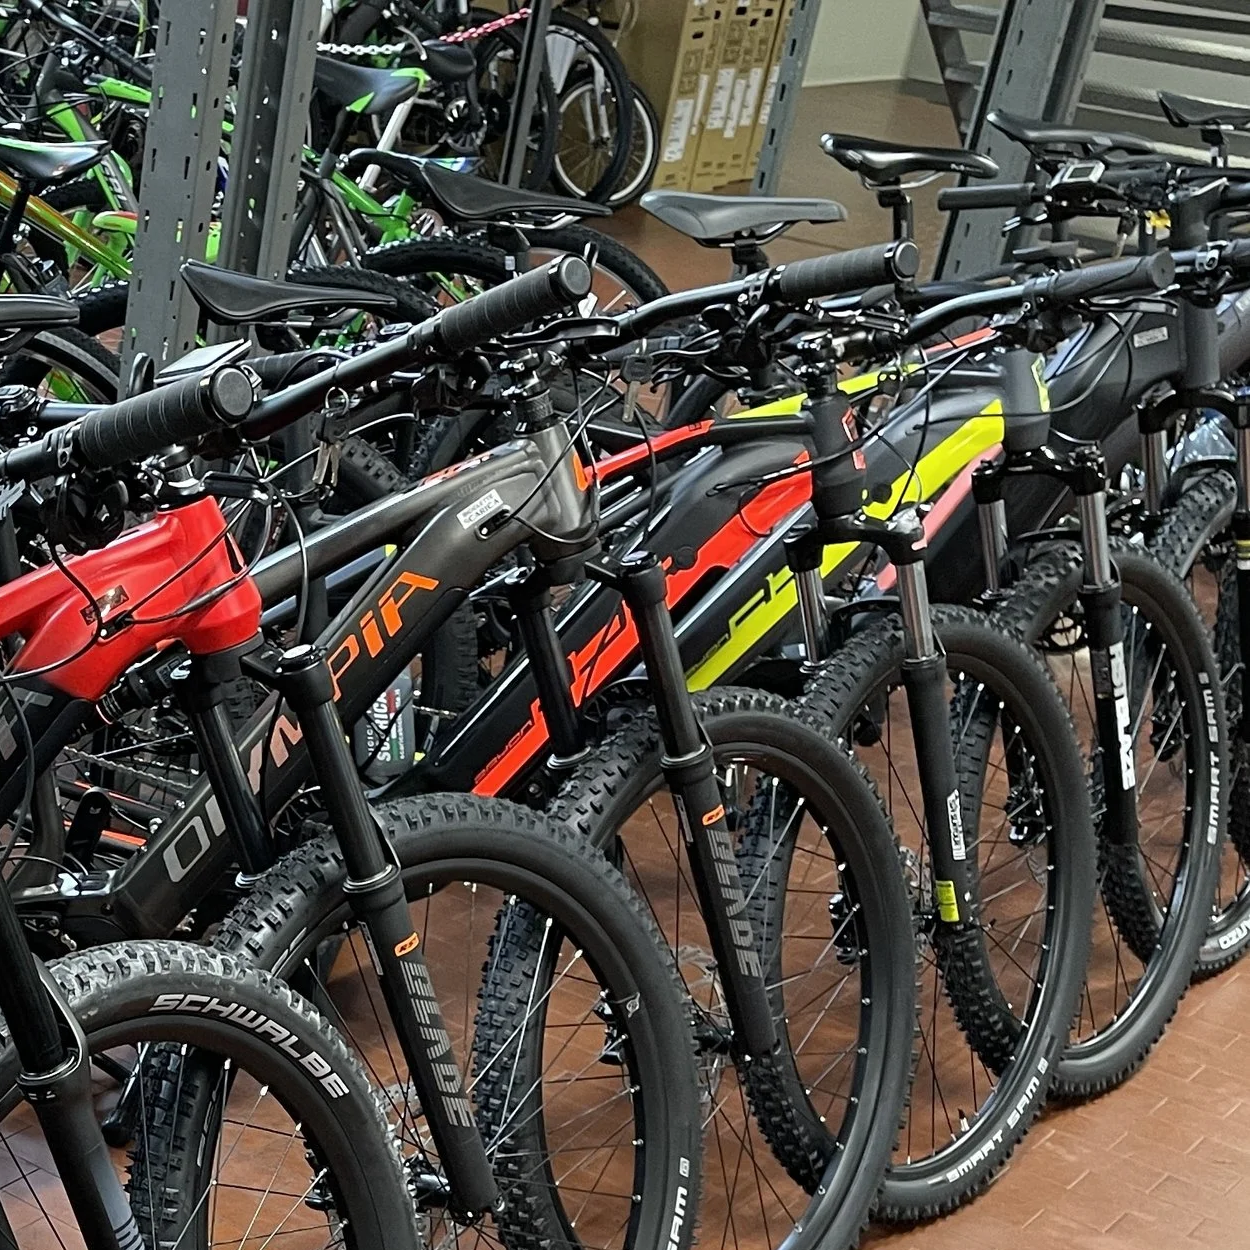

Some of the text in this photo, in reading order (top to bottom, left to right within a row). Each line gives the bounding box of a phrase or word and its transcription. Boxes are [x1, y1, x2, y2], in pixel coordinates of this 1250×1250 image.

[1203, 689, 1219, 743] SAM
[1207, 751, 1220, 845] SMART
[149, 993, 350, 1099] SCHWALBE
[946, 1076, 1040, 1183] SMART SAM
